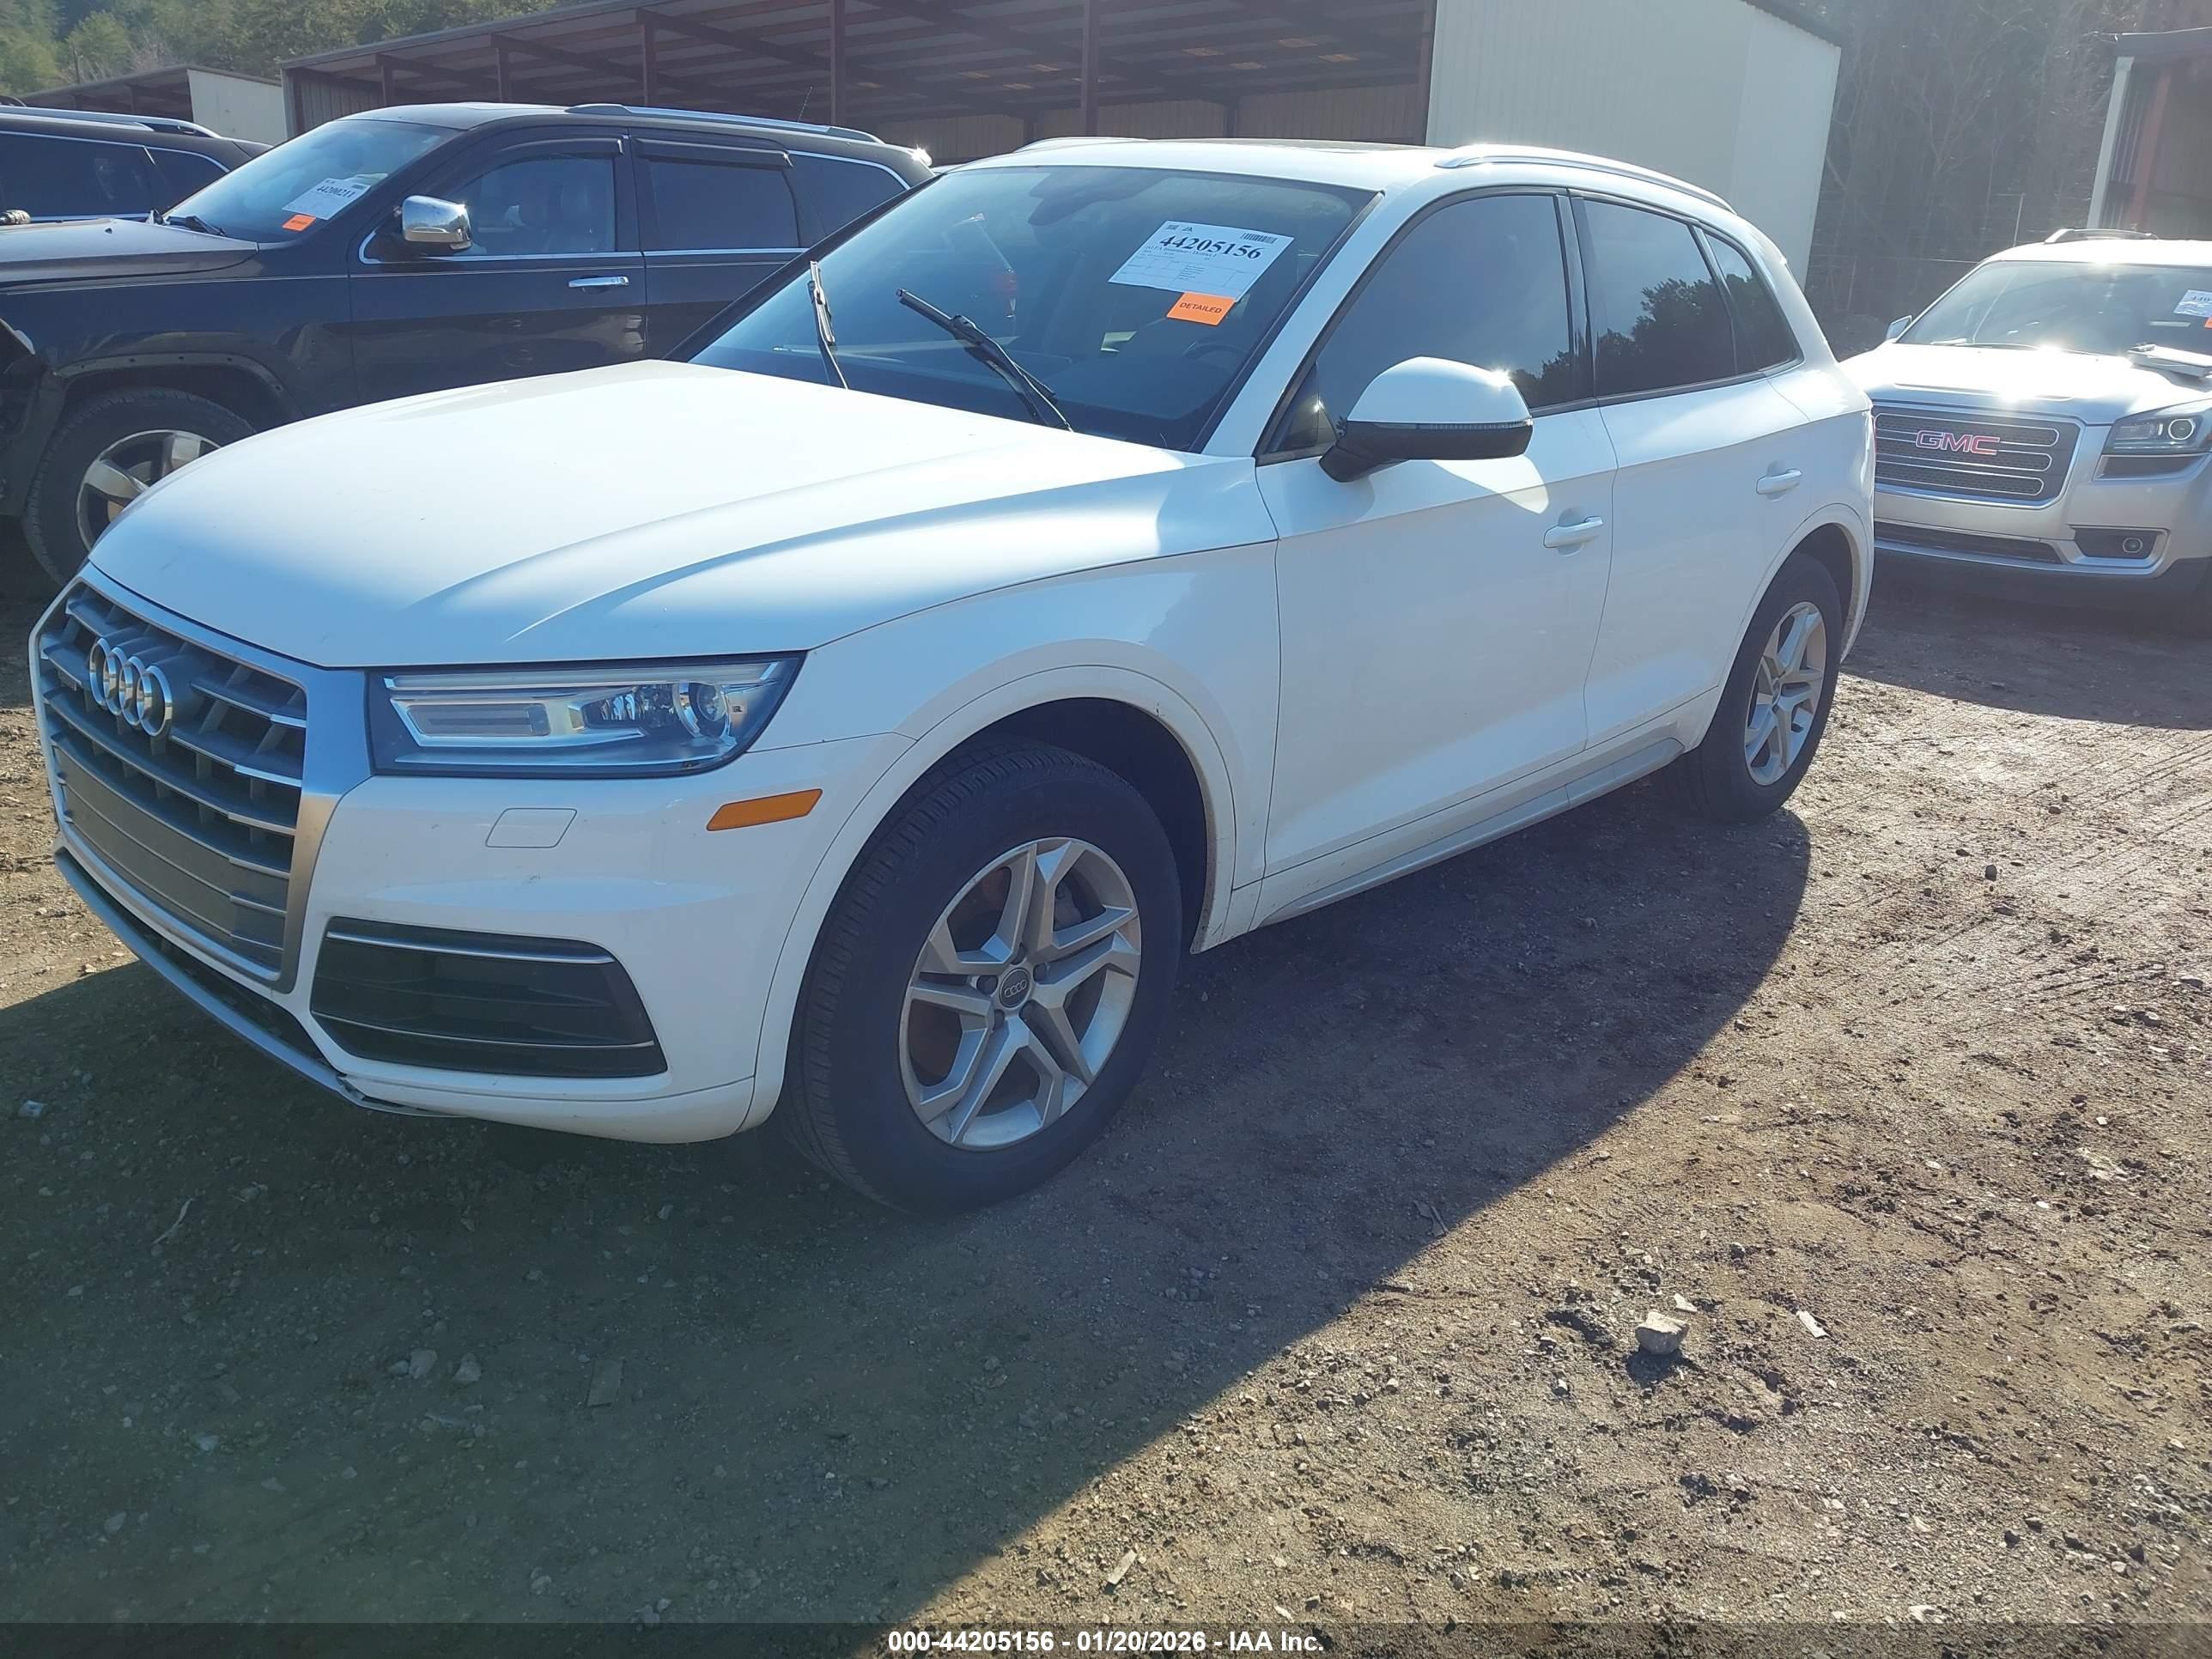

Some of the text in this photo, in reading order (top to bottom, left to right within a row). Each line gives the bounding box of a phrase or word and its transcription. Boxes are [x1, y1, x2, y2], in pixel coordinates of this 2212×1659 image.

[1159, 235, 1263, 258] 44205156
[1180, 301, 1222, 313] DETAILED
[1916, 430, 2001, 456] GMC
